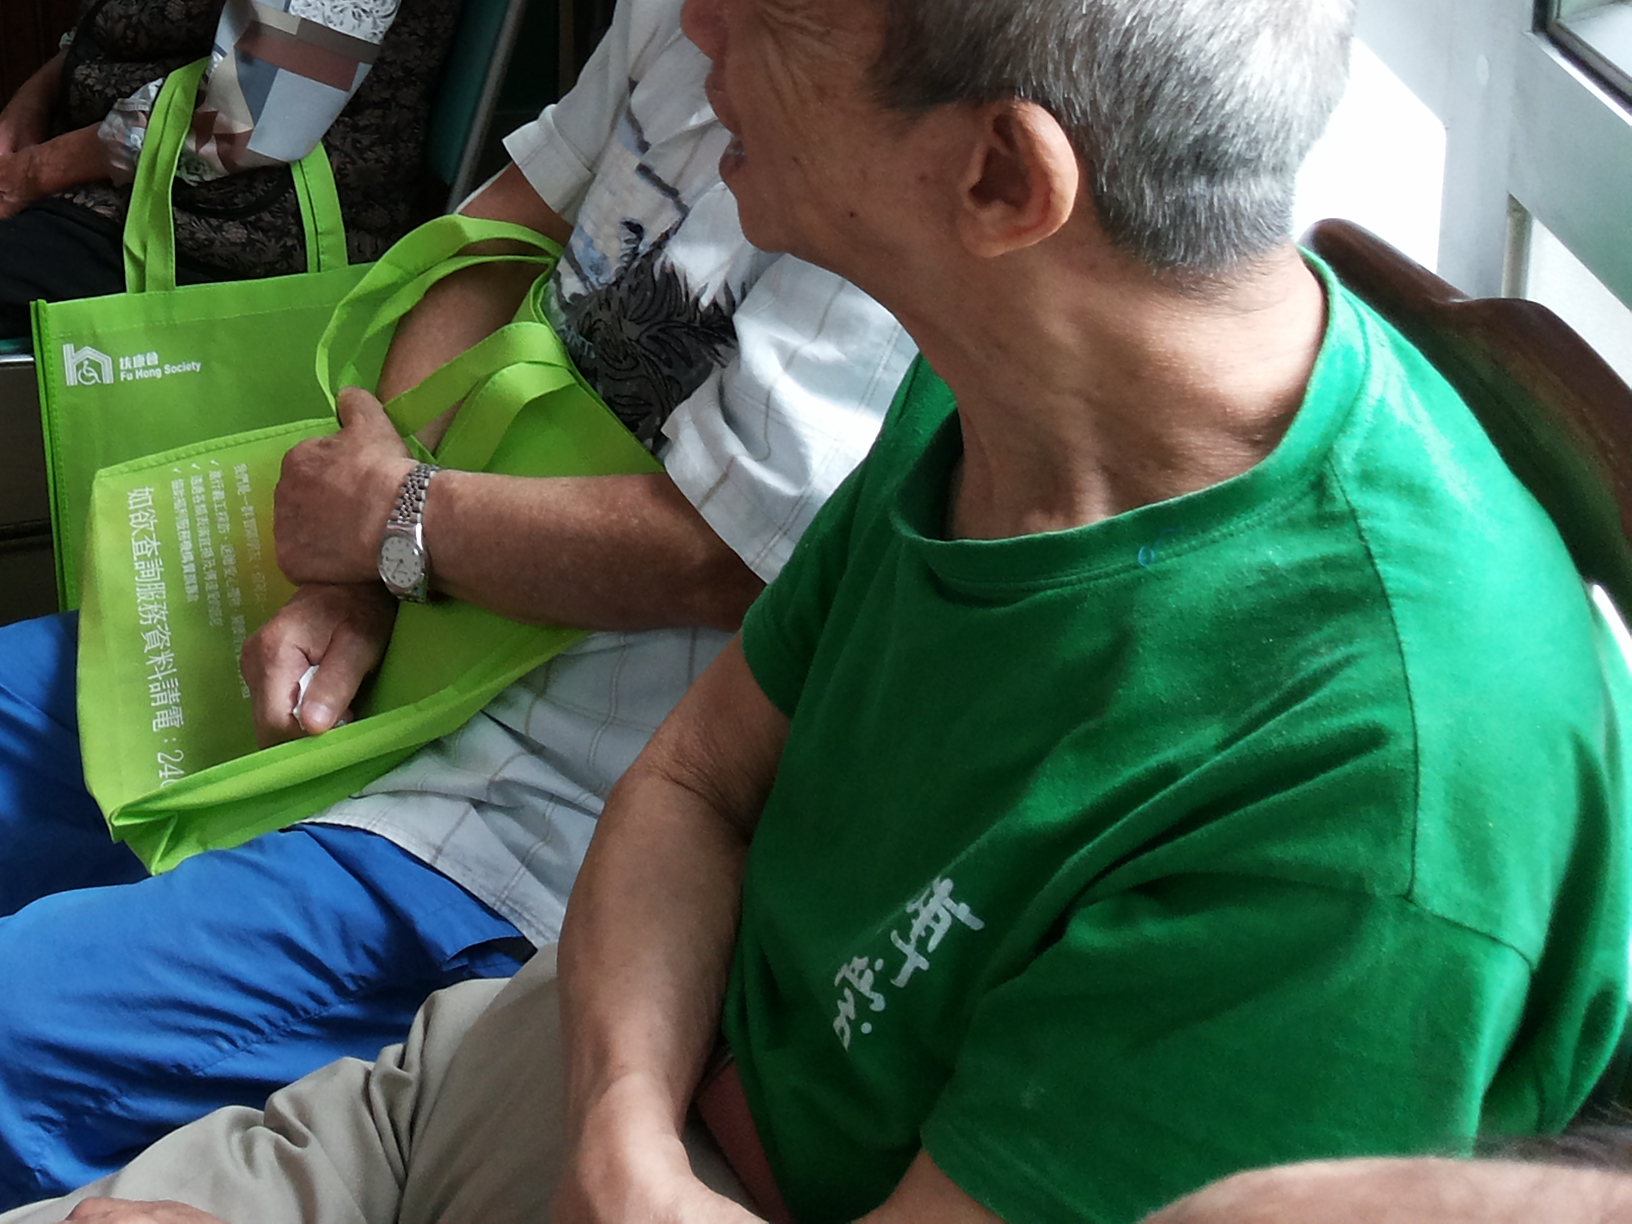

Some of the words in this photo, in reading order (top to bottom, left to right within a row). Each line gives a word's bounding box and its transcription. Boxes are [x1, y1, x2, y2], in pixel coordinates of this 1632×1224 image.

[120, 370, 134, 382] Fu
[135, 367, 163, 380] Hong
[163, 360, 202, 375] Society
